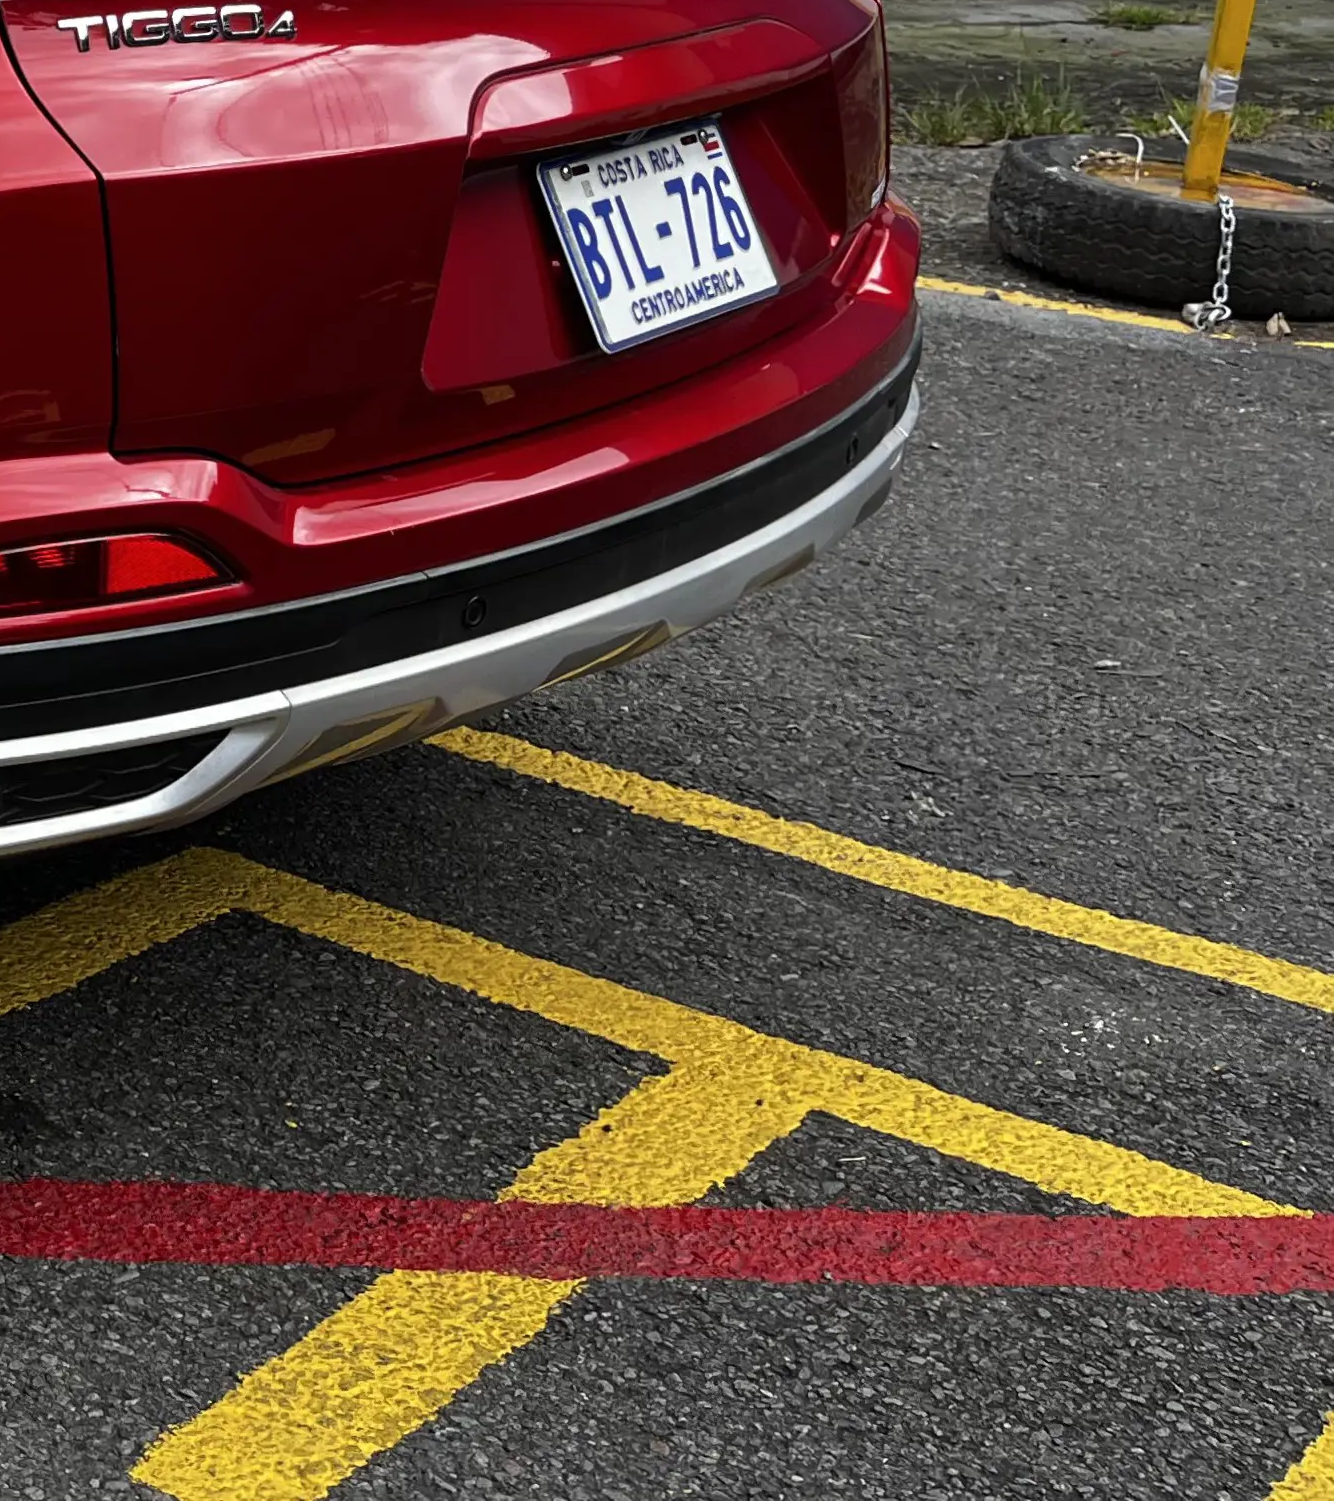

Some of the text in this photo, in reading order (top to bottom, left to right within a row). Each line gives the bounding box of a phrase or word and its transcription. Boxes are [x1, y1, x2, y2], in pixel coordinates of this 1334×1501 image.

[56, 3, 297, 52] TIGGO 4
[597, 144, 685, 188] COSTA RICA
[566, 166, 751, 300] BTL-726
[630, 267, 745, 325] CENTROAMERICA
